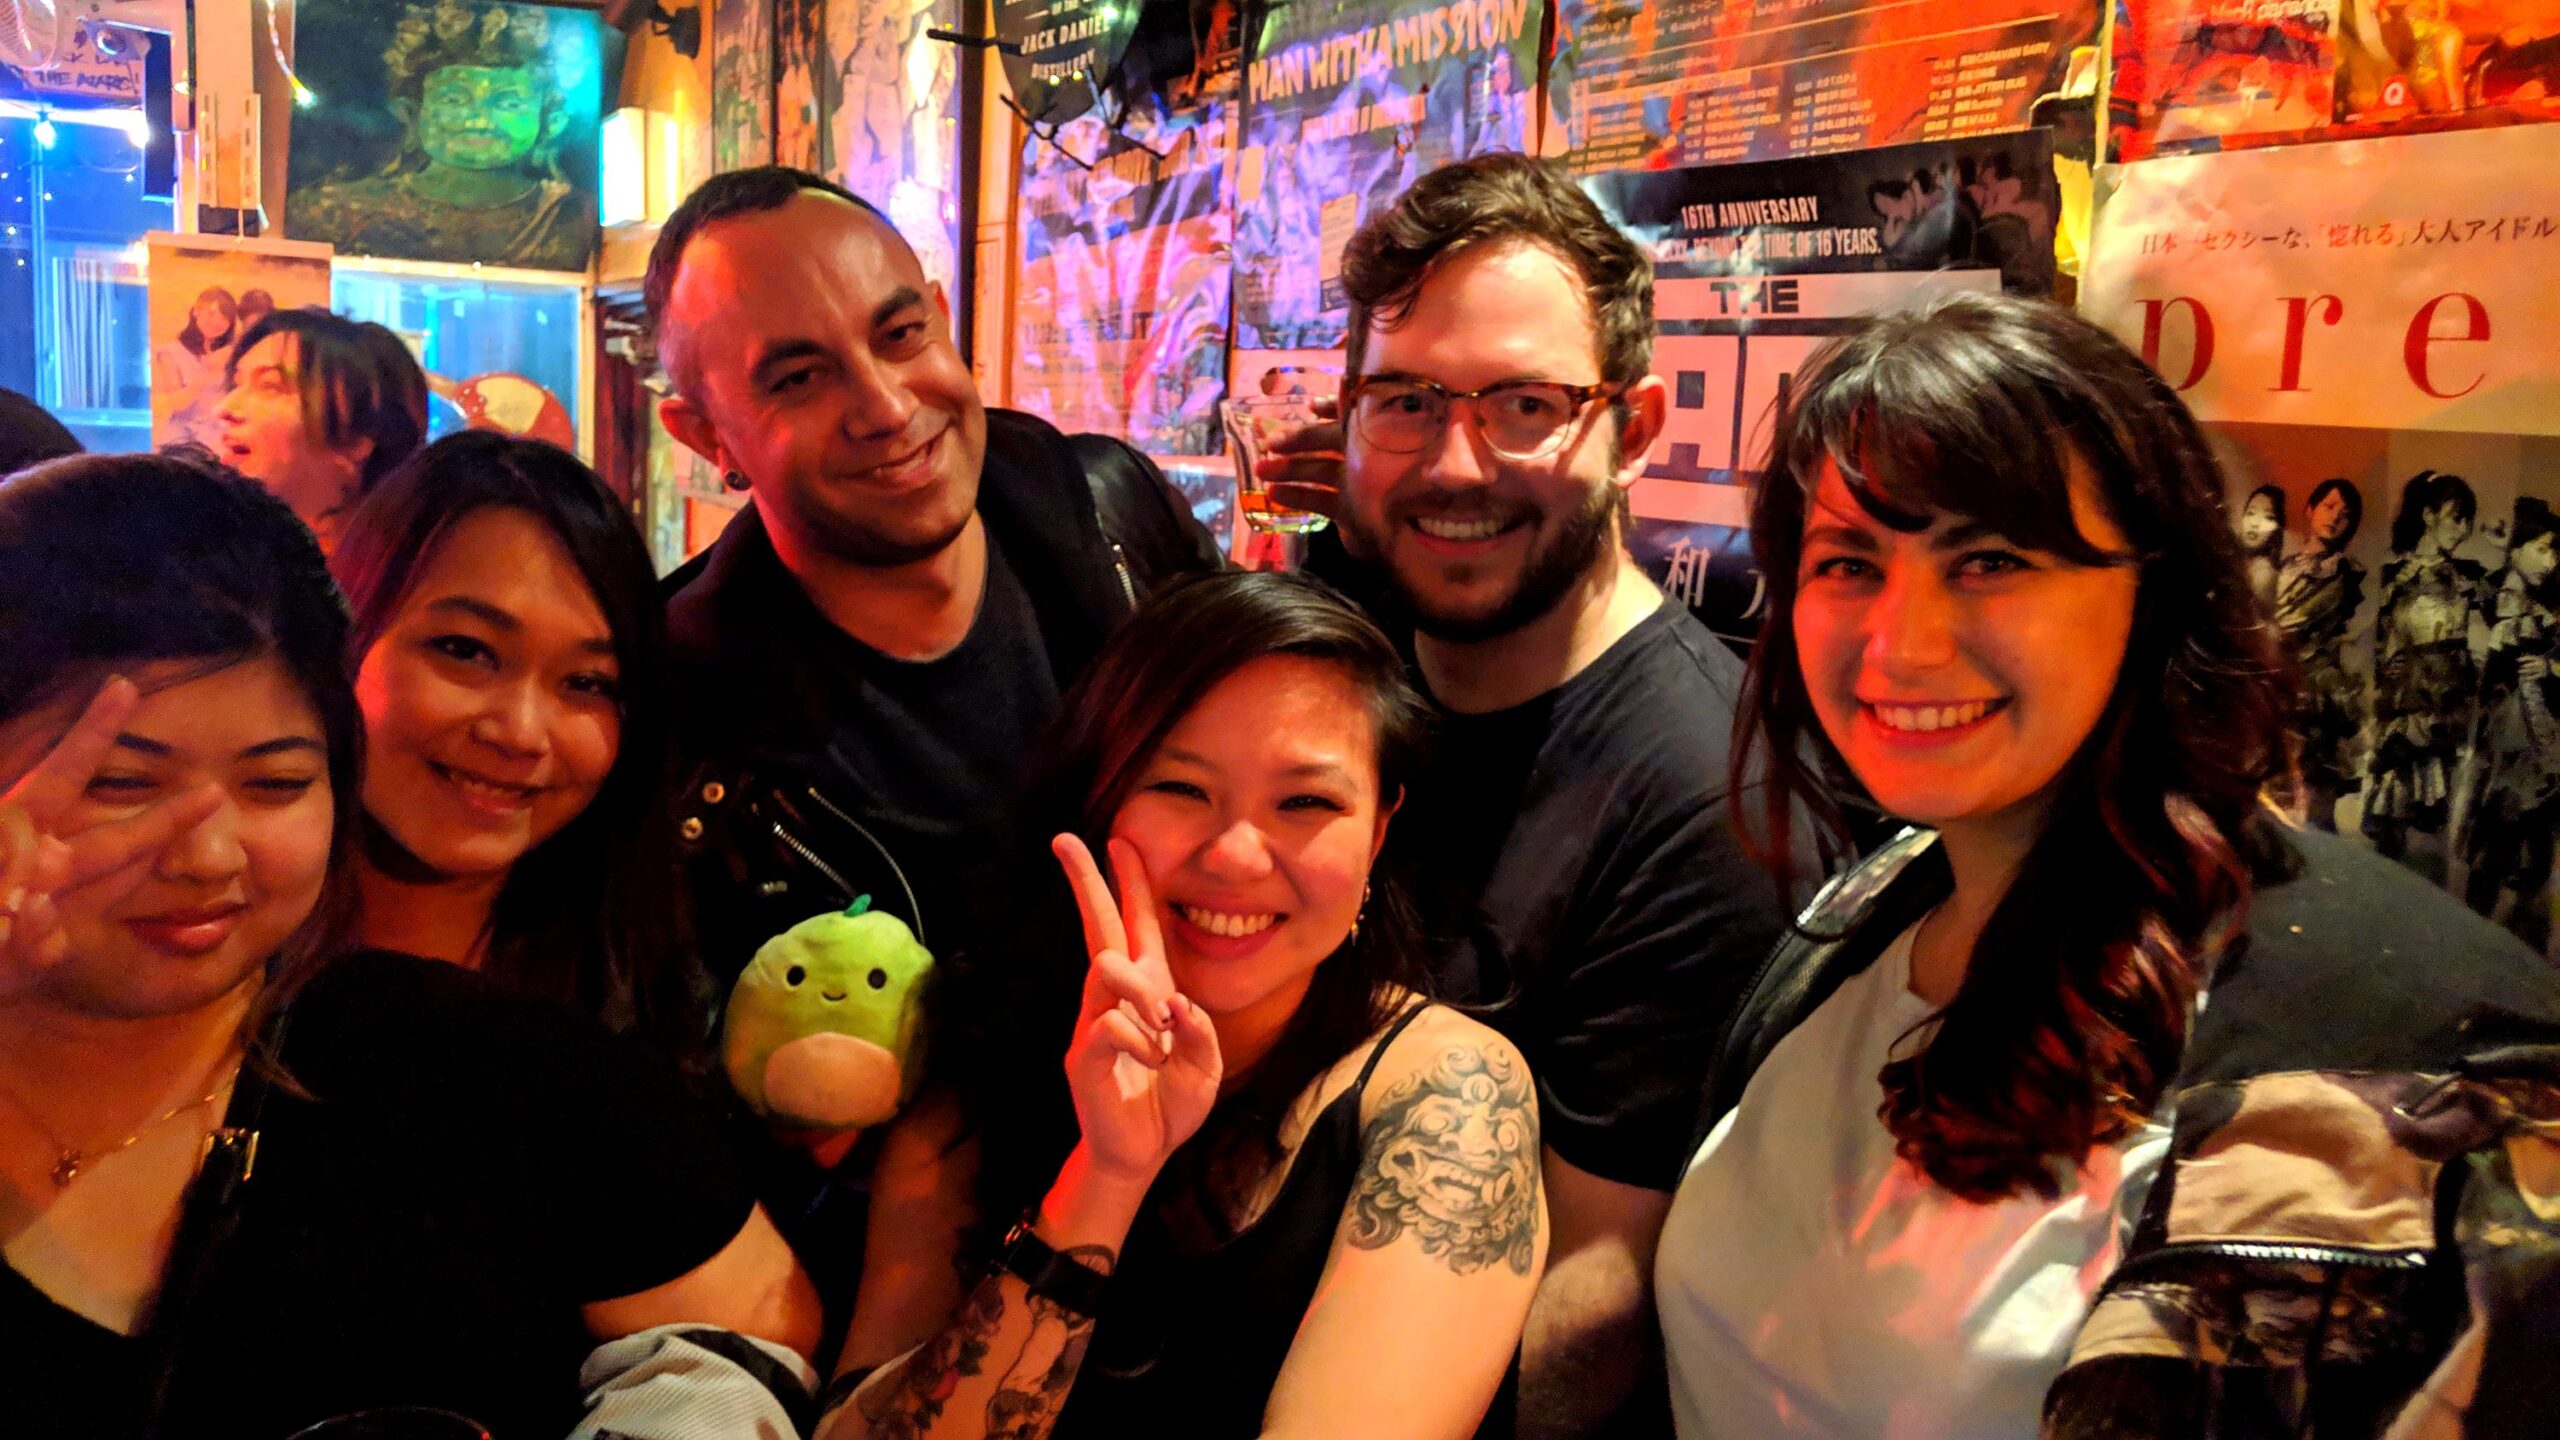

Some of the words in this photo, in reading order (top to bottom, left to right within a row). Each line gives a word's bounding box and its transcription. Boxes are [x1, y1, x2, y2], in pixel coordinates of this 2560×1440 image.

[1020, 28, 1056, 55] JACK
[1249, 48, 1304, 104] MAN
[1393, 0, 1527, 68] MISSION
[1681, 203, 1715, 231] 16TH
[1719, 196, 1819, 228] ANNIVERSARY
[1763, 231, 1794, 259] TIME
[1796, 230, 1813, 258] OF
[1816, 230, 1832, 257] 16
[1834, 226, 1883, 256] YEARS.
[1710, 279, 1800, 314] THE
[2133, 291, 2491, 399] pre
